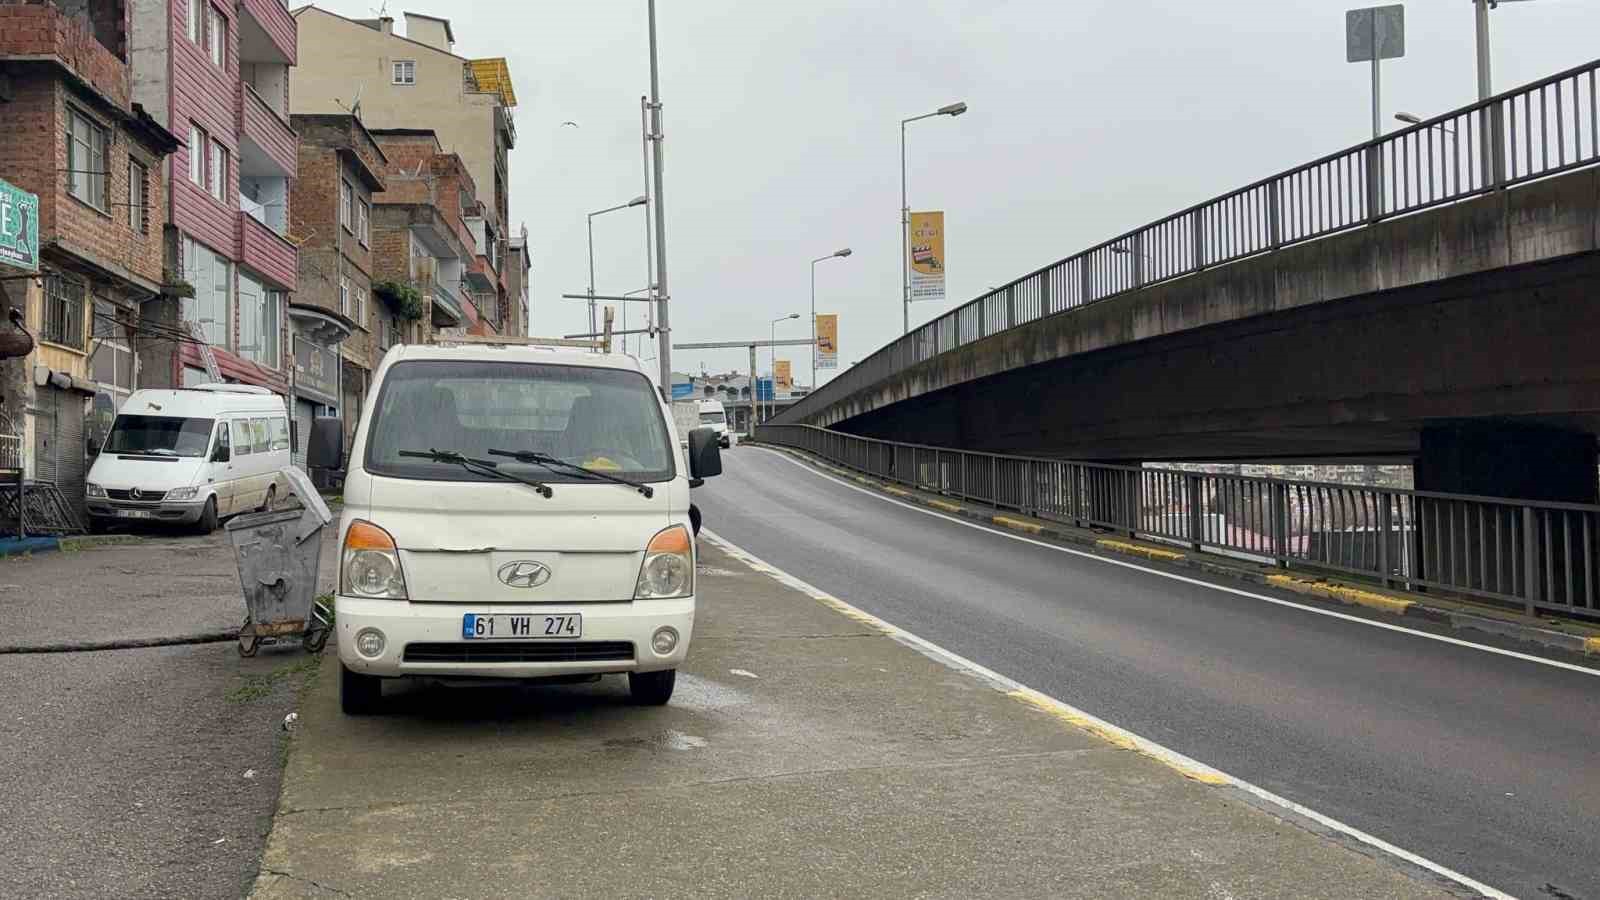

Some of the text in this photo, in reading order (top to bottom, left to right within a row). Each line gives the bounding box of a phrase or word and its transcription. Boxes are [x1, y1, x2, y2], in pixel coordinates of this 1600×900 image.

[475, 617, 575, 636] 61 VH 274
